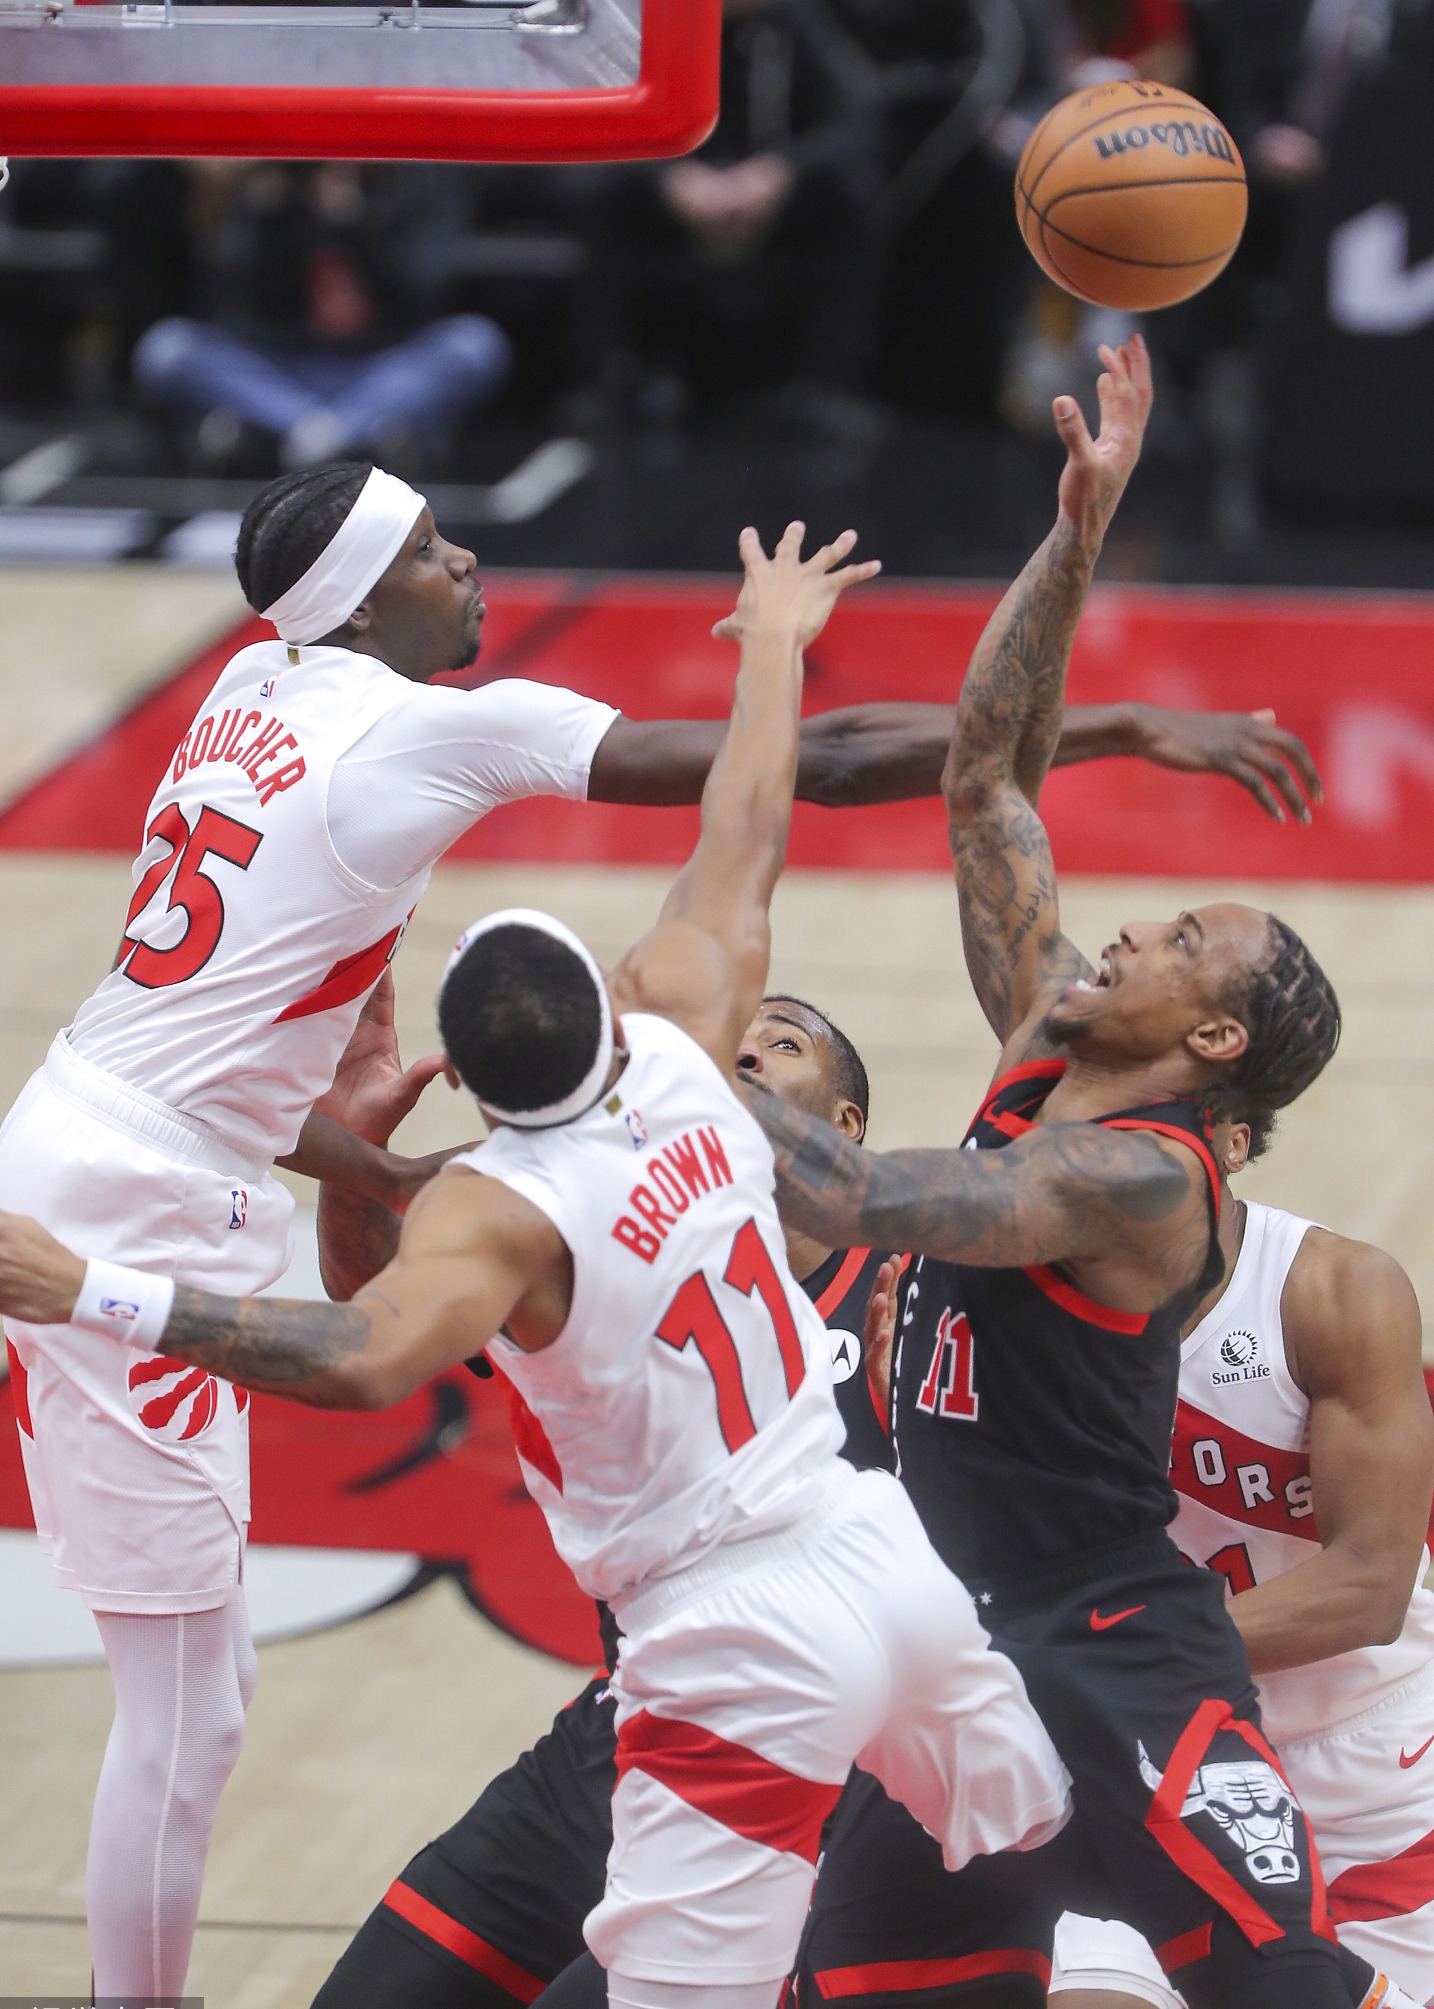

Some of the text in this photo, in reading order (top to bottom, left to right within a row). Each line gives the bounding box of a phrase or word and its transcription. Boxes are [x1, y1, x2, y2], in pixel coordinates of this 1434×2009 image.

[1094, 121, 1237, 166] Wilson
[173, 708, 306, 808] BOUCHER
[119, 802, 264, 989] 25
[611, 1124, 734, 1265] BROWN
[654, 1216, 806, 1455] 11
[915, 1306, 979, 1421] 11
[1212, 1365, 1270, 1385] Sun Life
